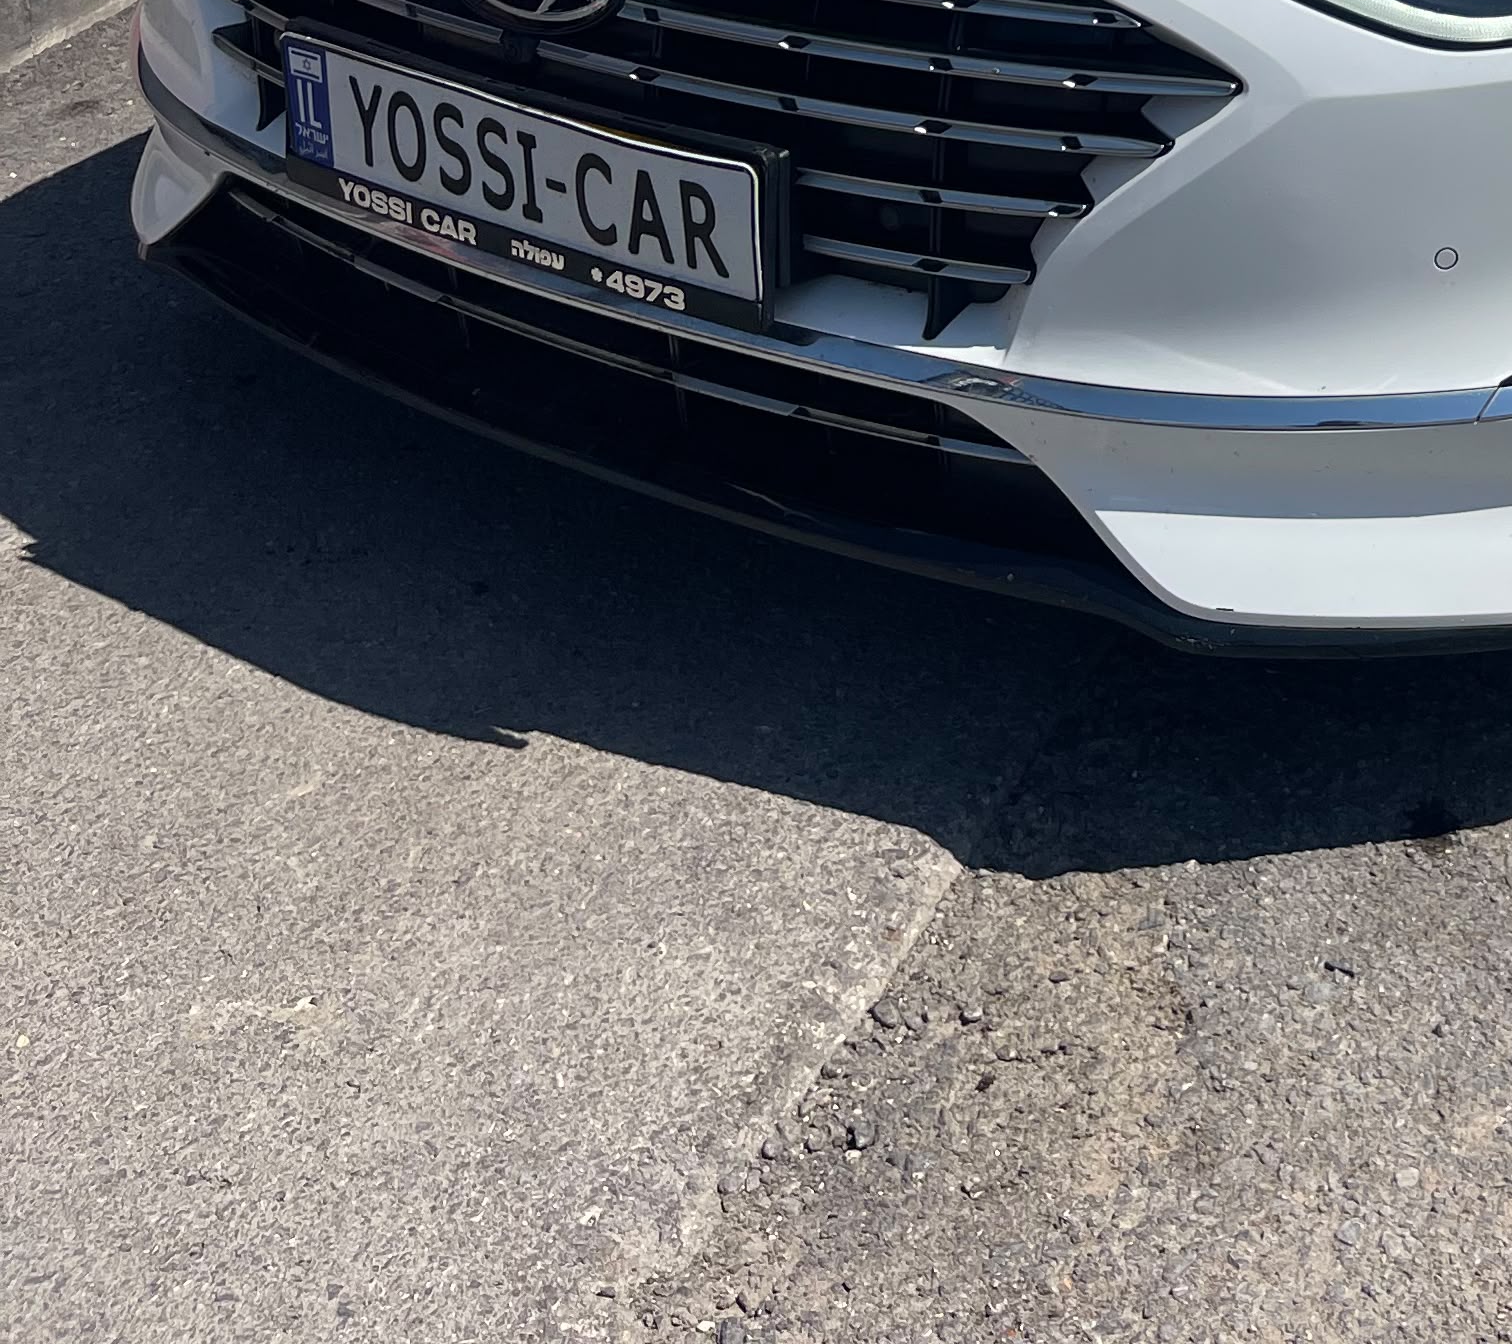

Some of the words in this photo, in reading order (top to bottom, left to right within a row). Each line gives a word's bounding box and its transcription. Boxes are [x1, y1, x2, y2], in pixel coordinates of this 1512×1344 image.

[297, 79, 322, 129] IL
[295, 122, 329, 145] ישראל
[349, 75, 729, 278] YOSSI-CAR
[338, 178, 413, 224] YOSSI
[420, 208, 477, 245] CAR
[511, 239, 564, 271] עפולה
